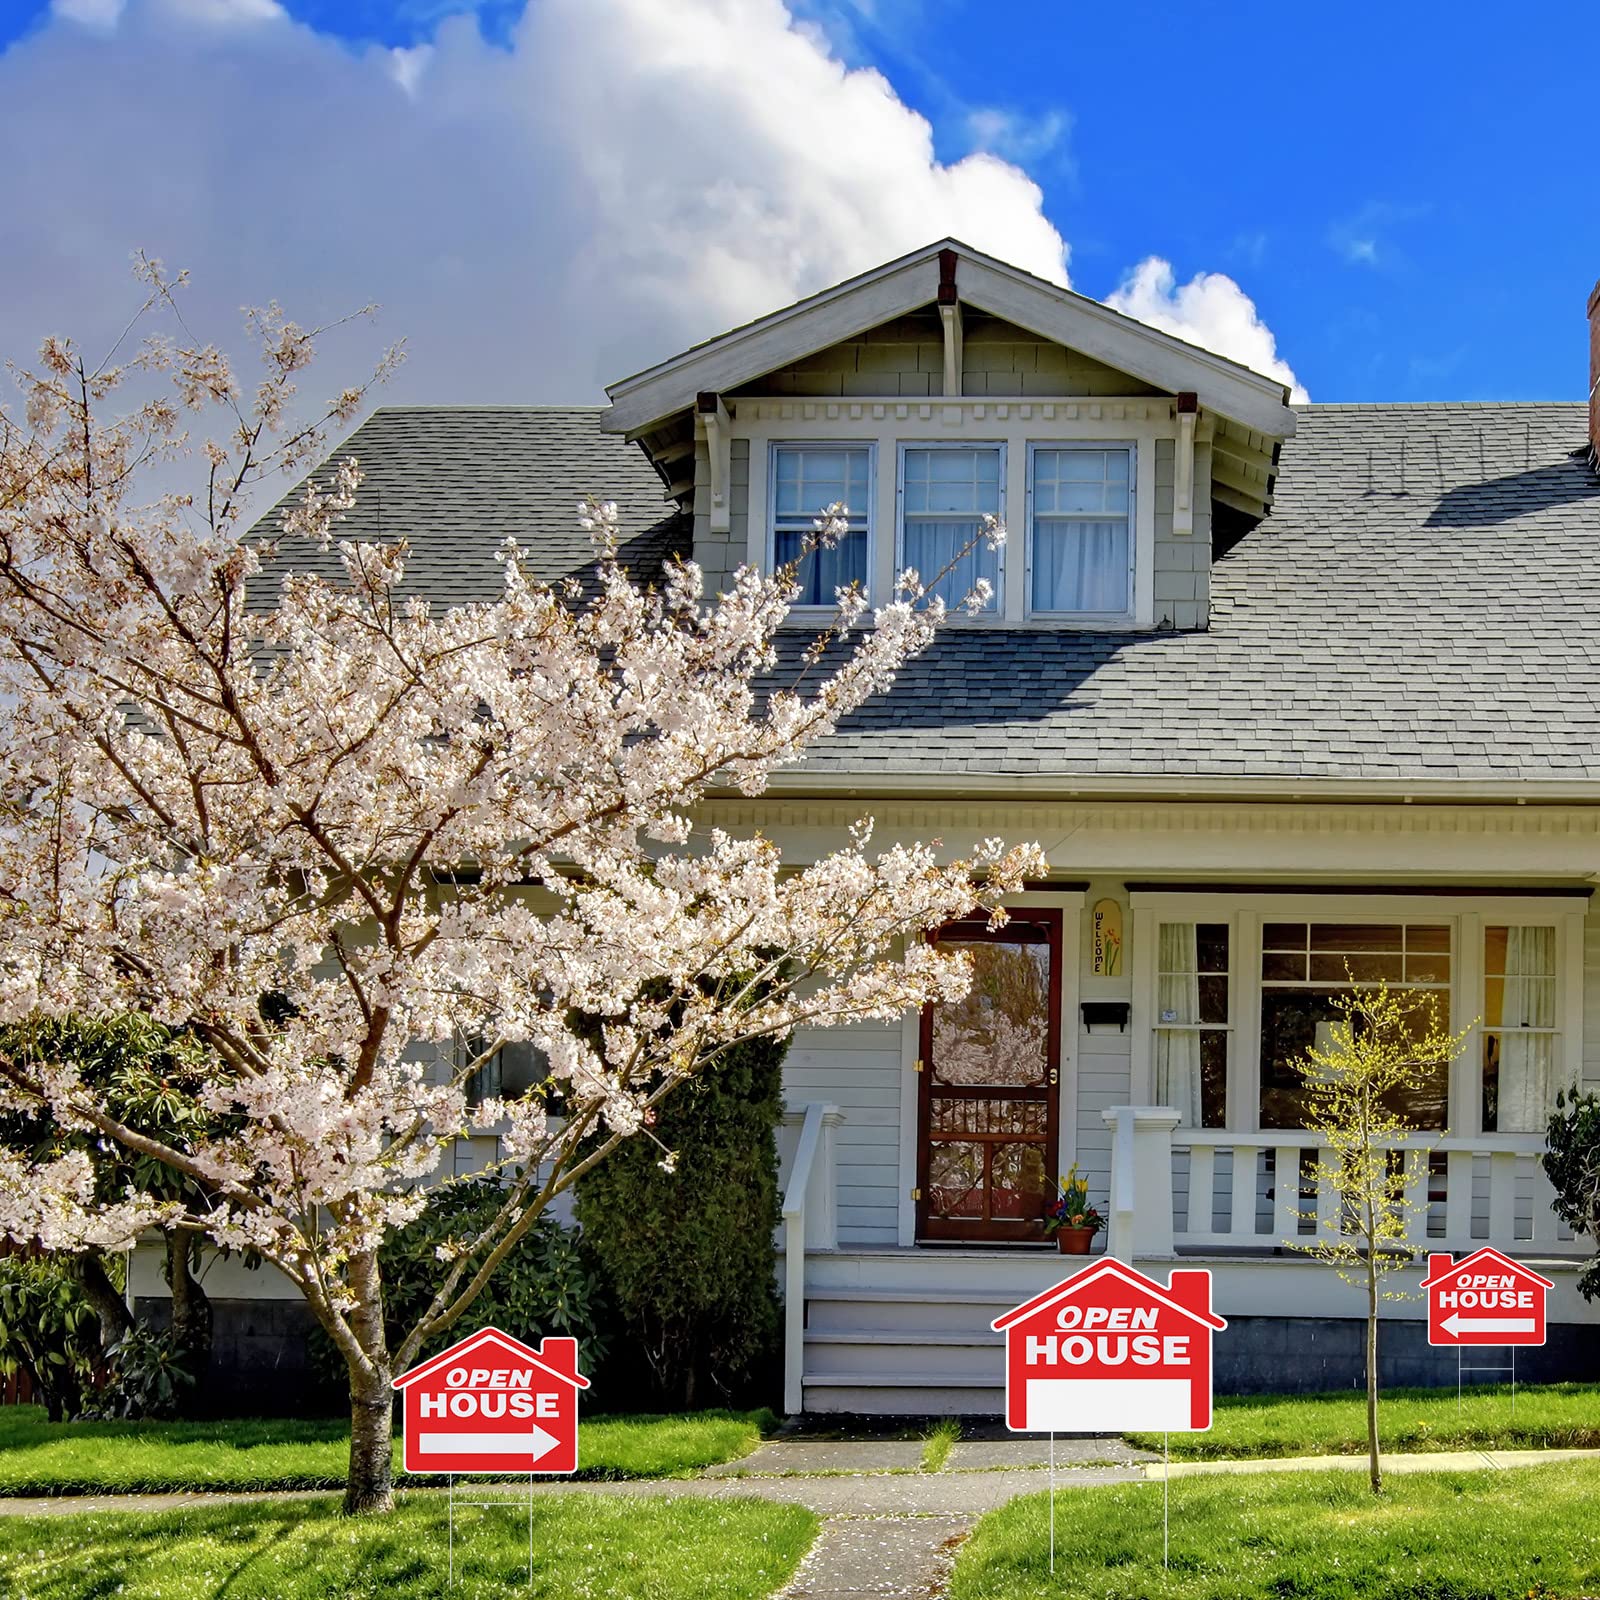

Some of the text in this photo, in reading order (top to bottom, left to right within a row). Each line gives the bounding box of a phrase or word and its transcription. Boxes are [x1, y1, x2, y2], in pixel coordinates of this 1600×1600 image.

[1095, 912, 1103, 972] WELCOME
[1456, 1274, 1516, 1288] OPEN
[1439, 1291, 1534, 1308] HOUSE
[1056, 1305, 1159, 1329] OPEN
[1025, 1335, 1191, 1366] HOUSE
[446, 1367, 533, 1388] OPEN
[420, 1392, 559, 1418] HOUSE
